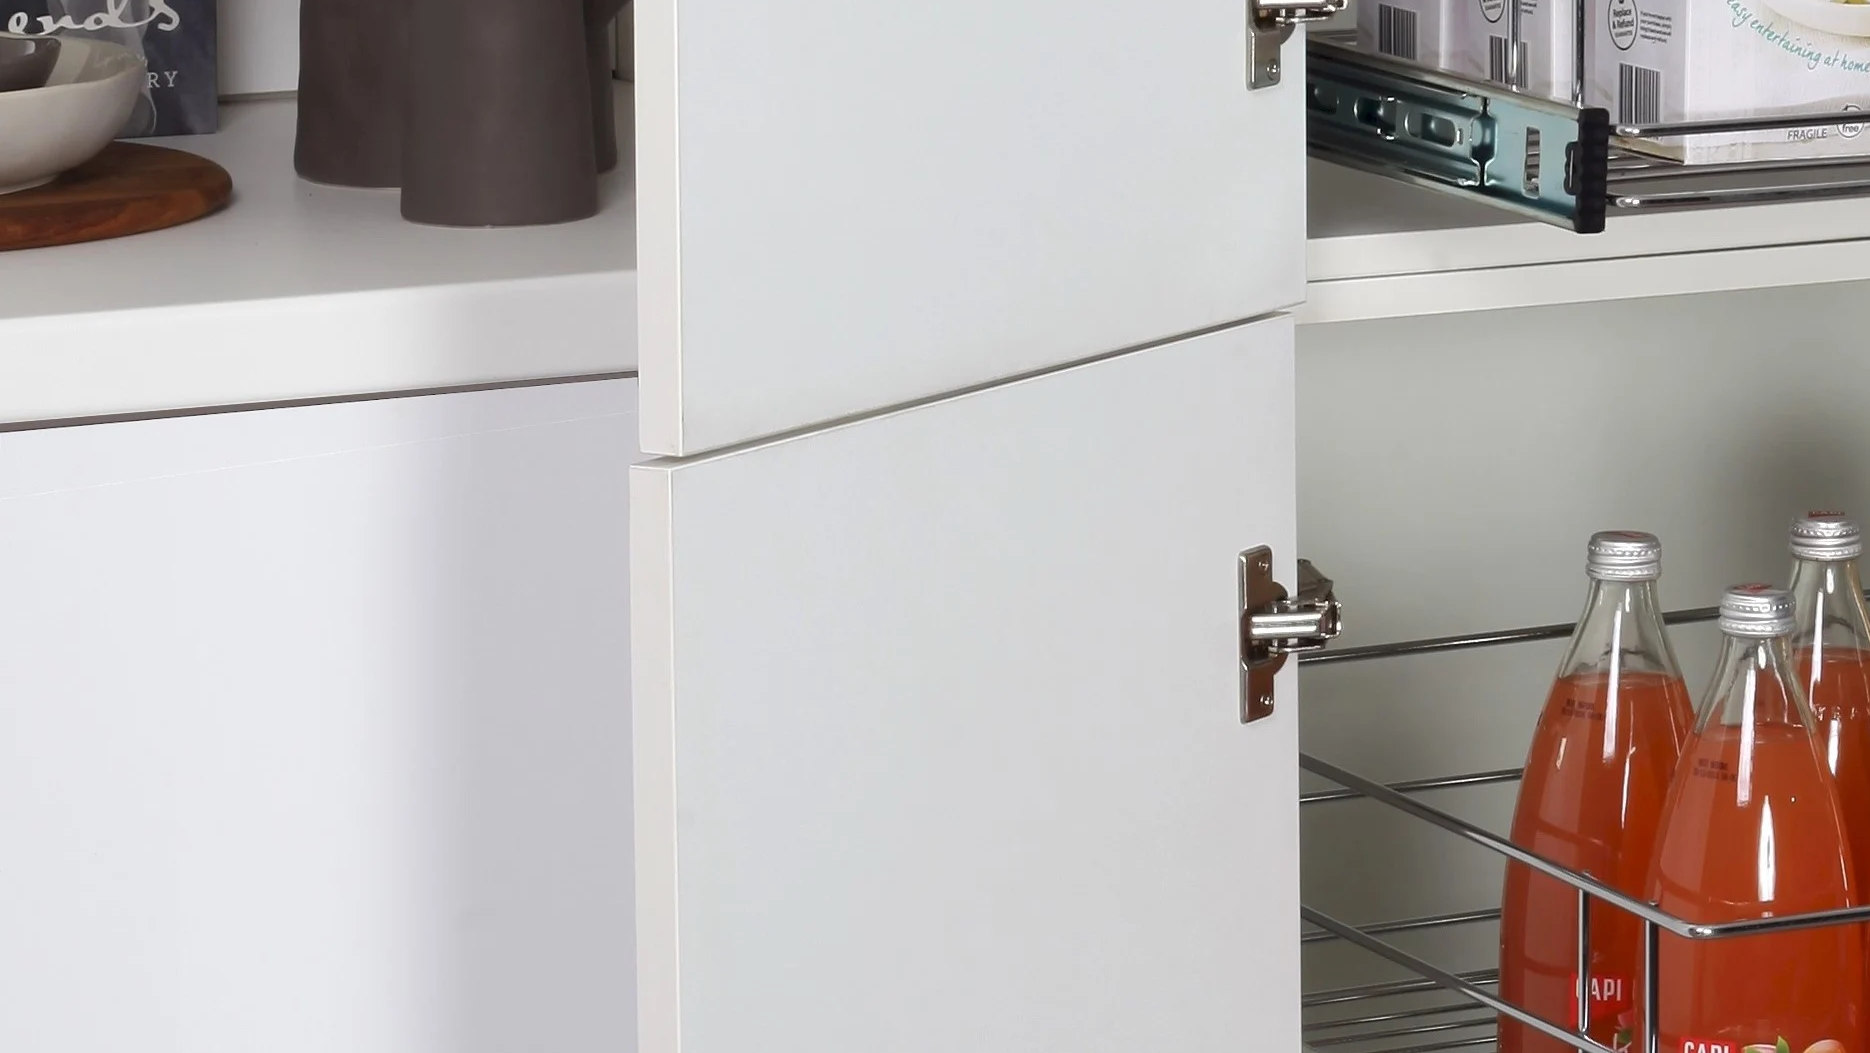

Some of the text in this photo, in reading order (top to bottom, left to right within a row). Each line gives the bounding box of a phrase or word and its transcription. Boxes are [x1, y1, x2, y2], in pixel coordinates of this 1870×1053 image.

[1749, 18, 1822, 70] entertaining
[1824, 50, 1840, 67] at
[1840, 54, 1870, 73] home
[1787, 128, 1828, 141] FRAGILE
[1576, 977, 1623, 1002] API
